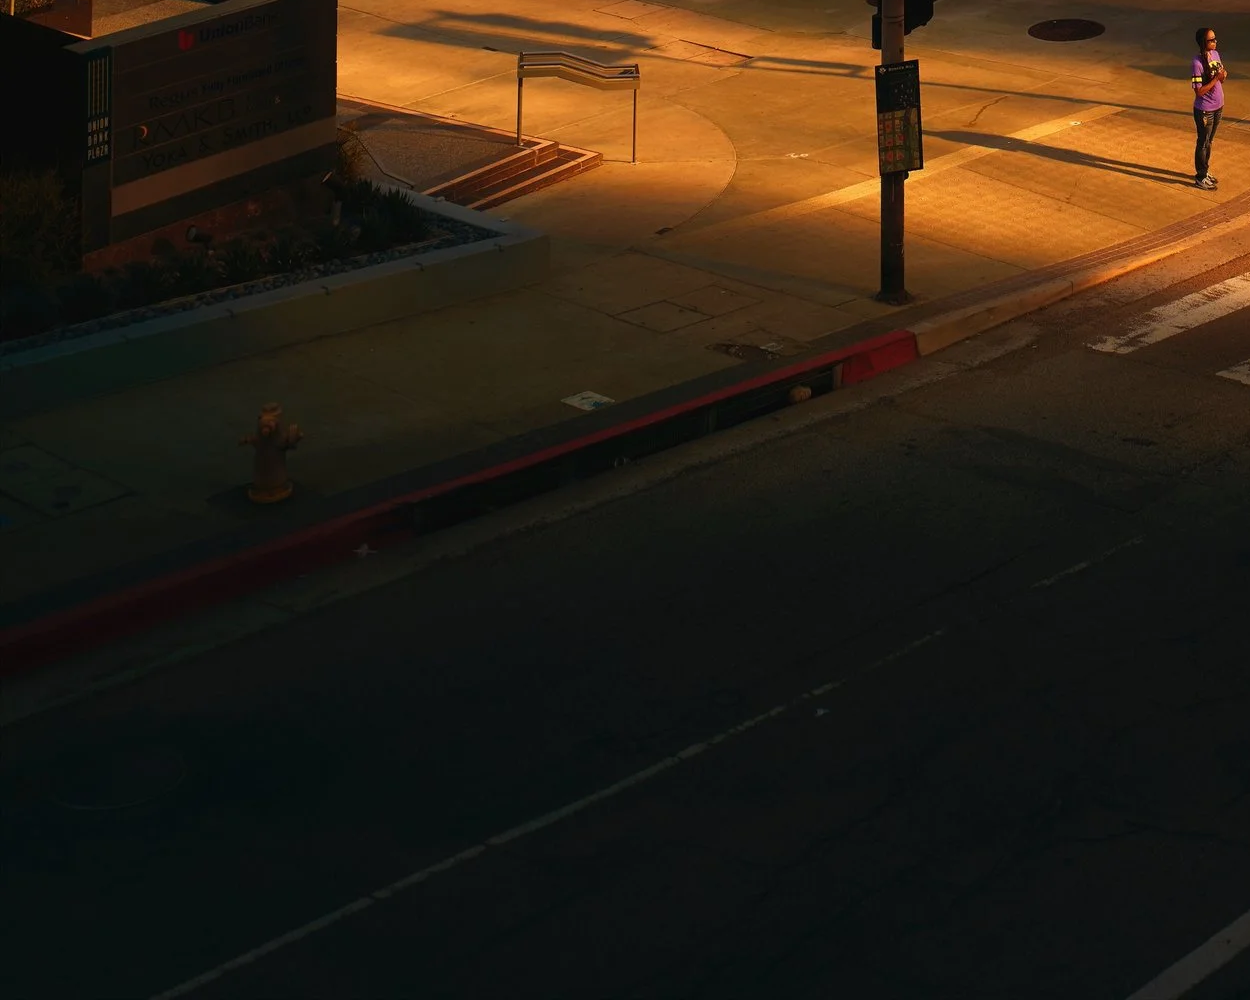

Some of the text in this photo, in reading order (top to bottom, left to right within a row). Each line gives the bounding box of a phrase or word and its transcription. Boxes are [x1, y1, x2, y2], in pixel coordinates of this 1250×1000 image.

[149, 87, 199, 110] Regus
[87, 116, 109, 133] UNION
[132, 98, 236, 151] RMKB
[87, 130, 109, 147] BANK
[142, 144, 188, 170] YOKA
[199, 135, 214, 153] &
[223, 119, 279, 147] SMITH,
[87, 144, 109, 161] PLAZA
